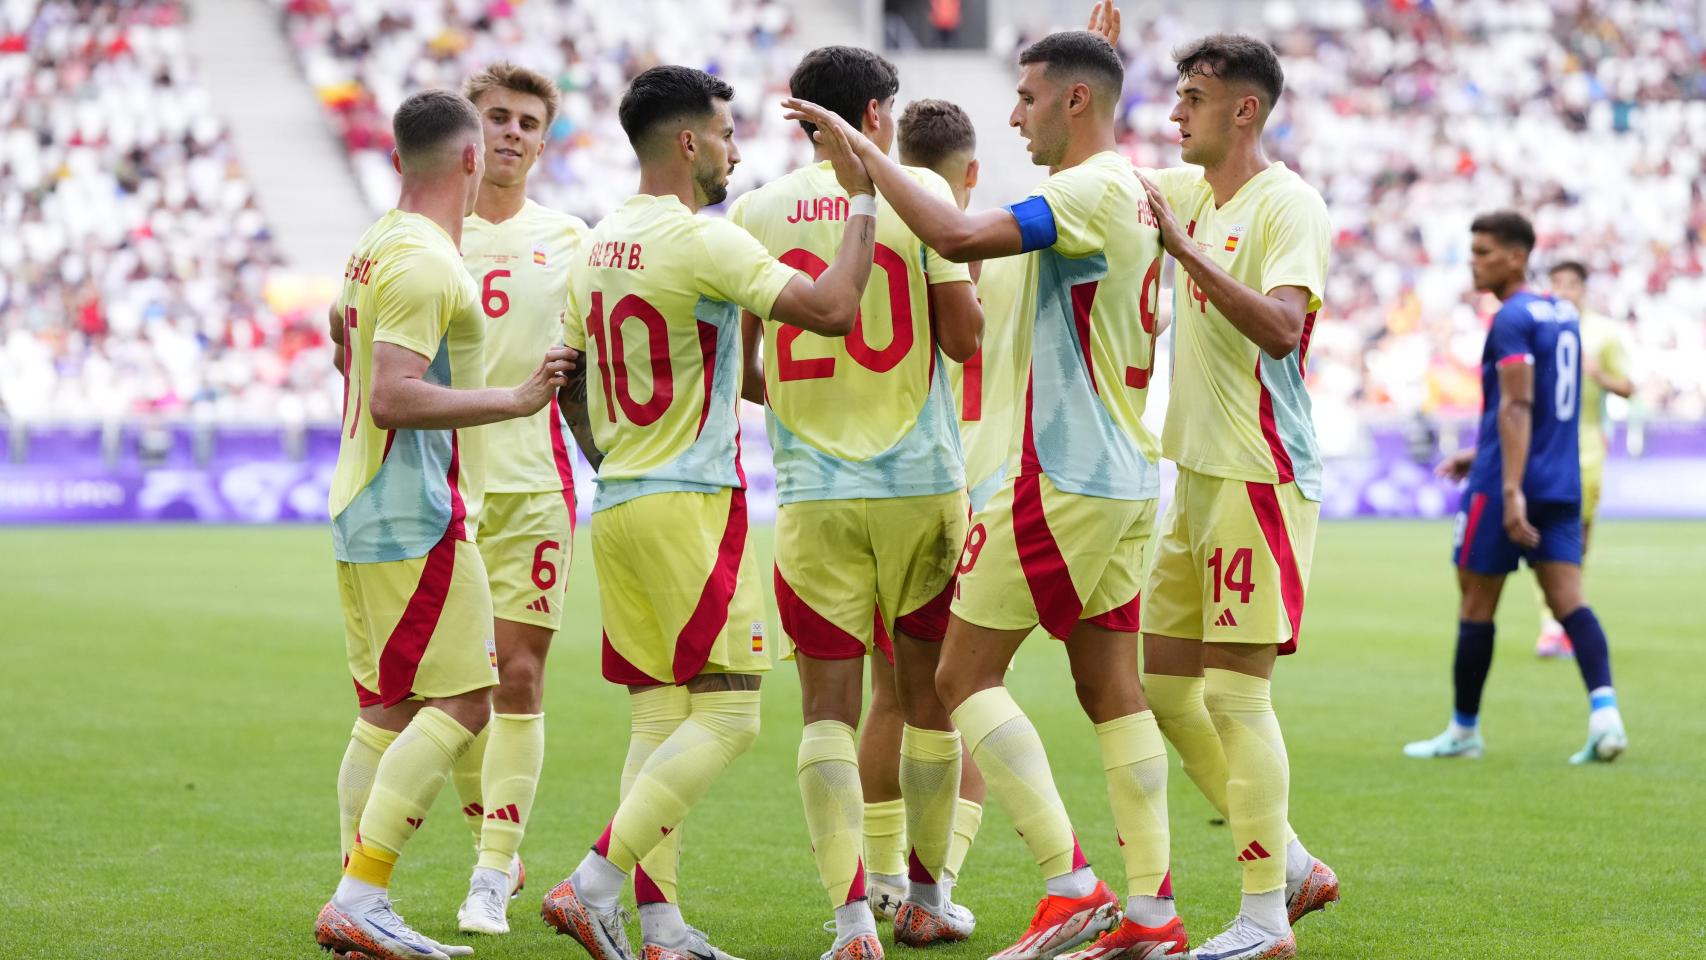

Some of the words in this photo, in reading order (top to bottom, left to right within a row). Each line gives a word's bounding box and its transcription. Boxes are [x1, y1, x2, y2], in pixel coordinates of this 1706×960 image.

[787, 196, 851, 224] JUAN
[588, 241, 626, 268] ALEX
[628, 243, 645, 270] B.
[481, 269, 512, 318] 6
[776, 241, 914, 382] 20
[585, 291, 674, 427] 10
[1555, 330, 1580, 421] 8
[531, 540, 560, 591] 6
[959, 522, 987, 575] 9
[1207, 547, 1256, 604] 14
